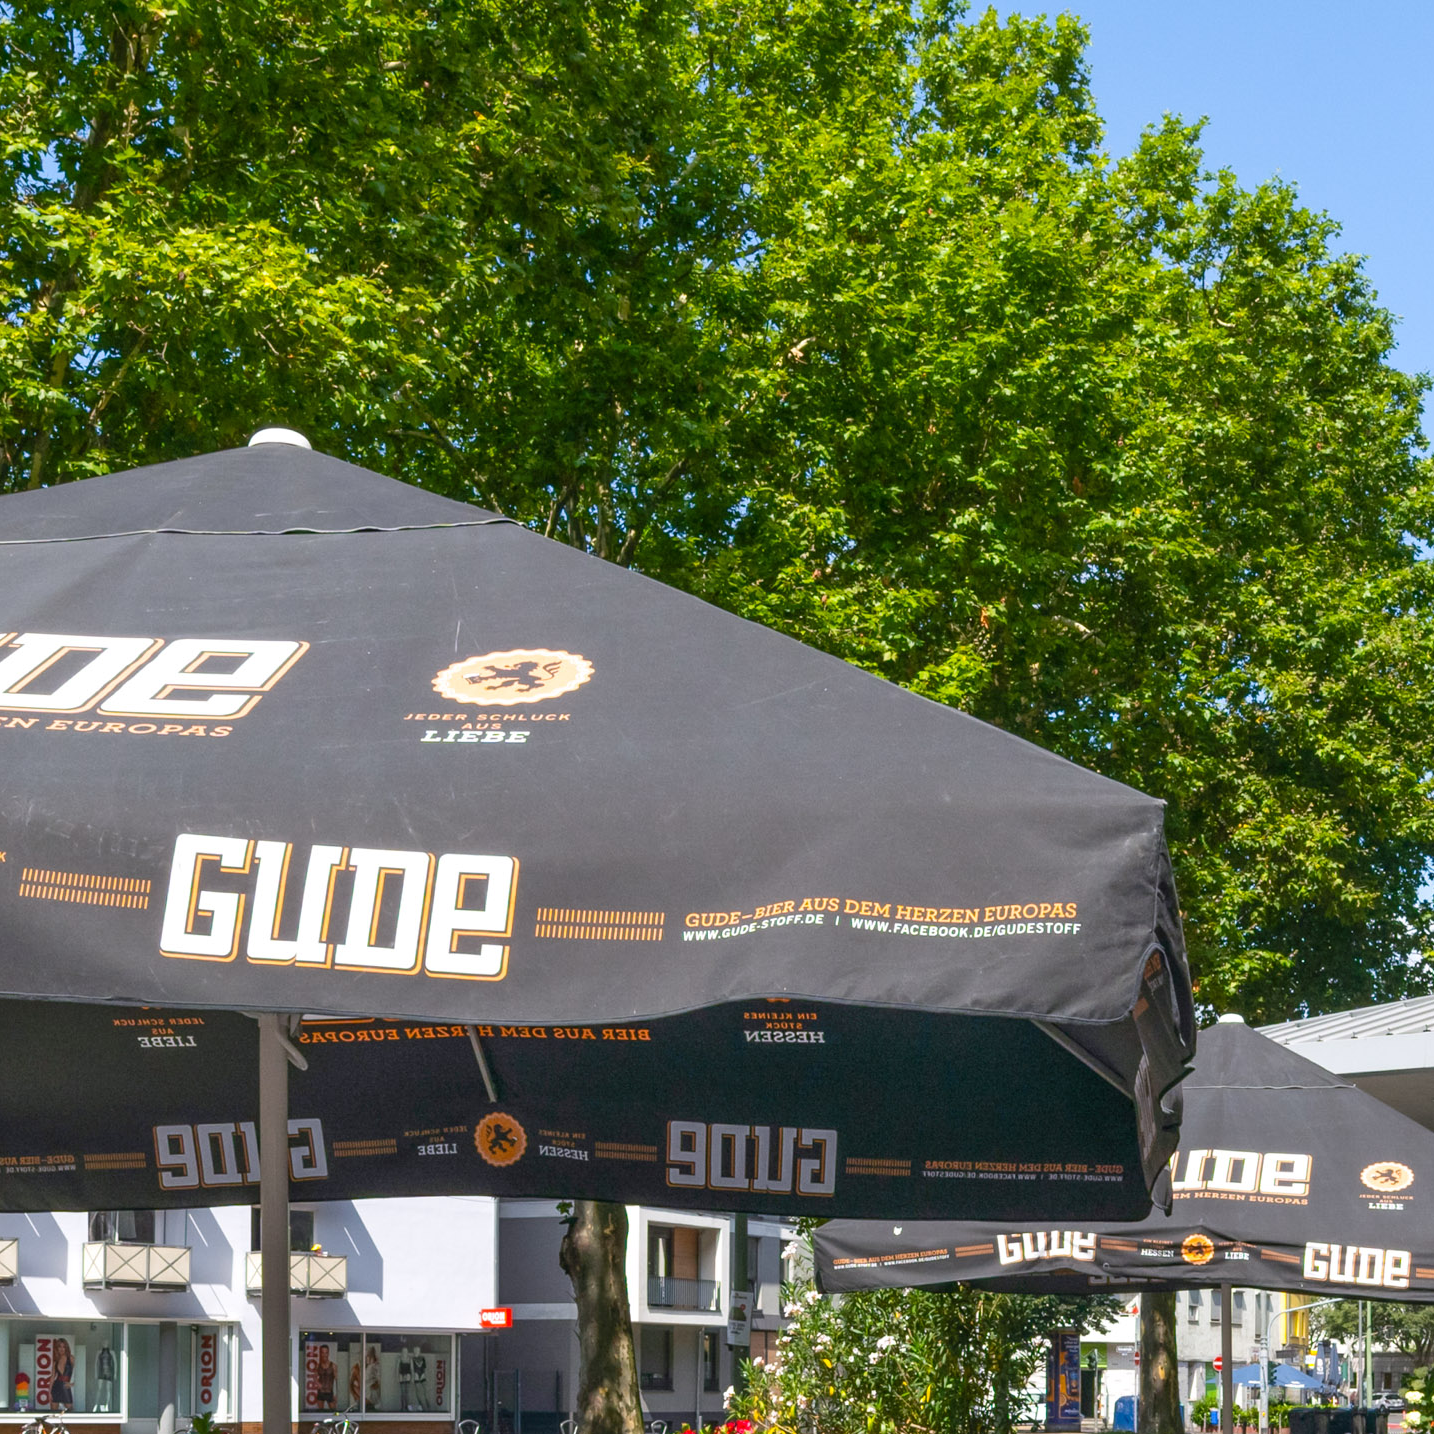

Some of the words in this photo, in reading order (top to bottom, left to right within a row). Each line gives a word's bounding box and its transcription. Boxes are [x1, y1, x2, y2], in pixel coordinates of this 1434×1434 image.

[403, 713, 467, 721] JEDER
[476, 713, 571, 721] SCHLUCK
[50, 719, 234, 738] EUROPAS
[460, 722, 502, 730] AUS
[420, 730, 531, 743] LIEBE
[799, 898, 839, 912] AUS
[844, 899, 891, 918] DEM
[896, 905, 980, 924] HERZEN
[983, 903, 1077, 922] EUROPAS
[683, 914, 824, 942] WWW.GUDE-STOFF.DE
[851, 917, 1081, 939] WWW.FACEBOOK.DE/GUDESTOFF
[1194, 1191, 1246, 1201] HERZEN
[1249, 1195, 1309, 1206] EUROPAS
[1368, 1202, 1404, 1211] LIEBE
[1140, 1248, 1175, 1258] HESSEN
[1225, 1251, 1250, 1261] LIEBE
[482, 1312, 506, 1324] ORION
[36, 1338, 52, 1405] ORION
[201, 1333, 217, 1405] ORION
[436, 1360, 446, 1406] ORION
